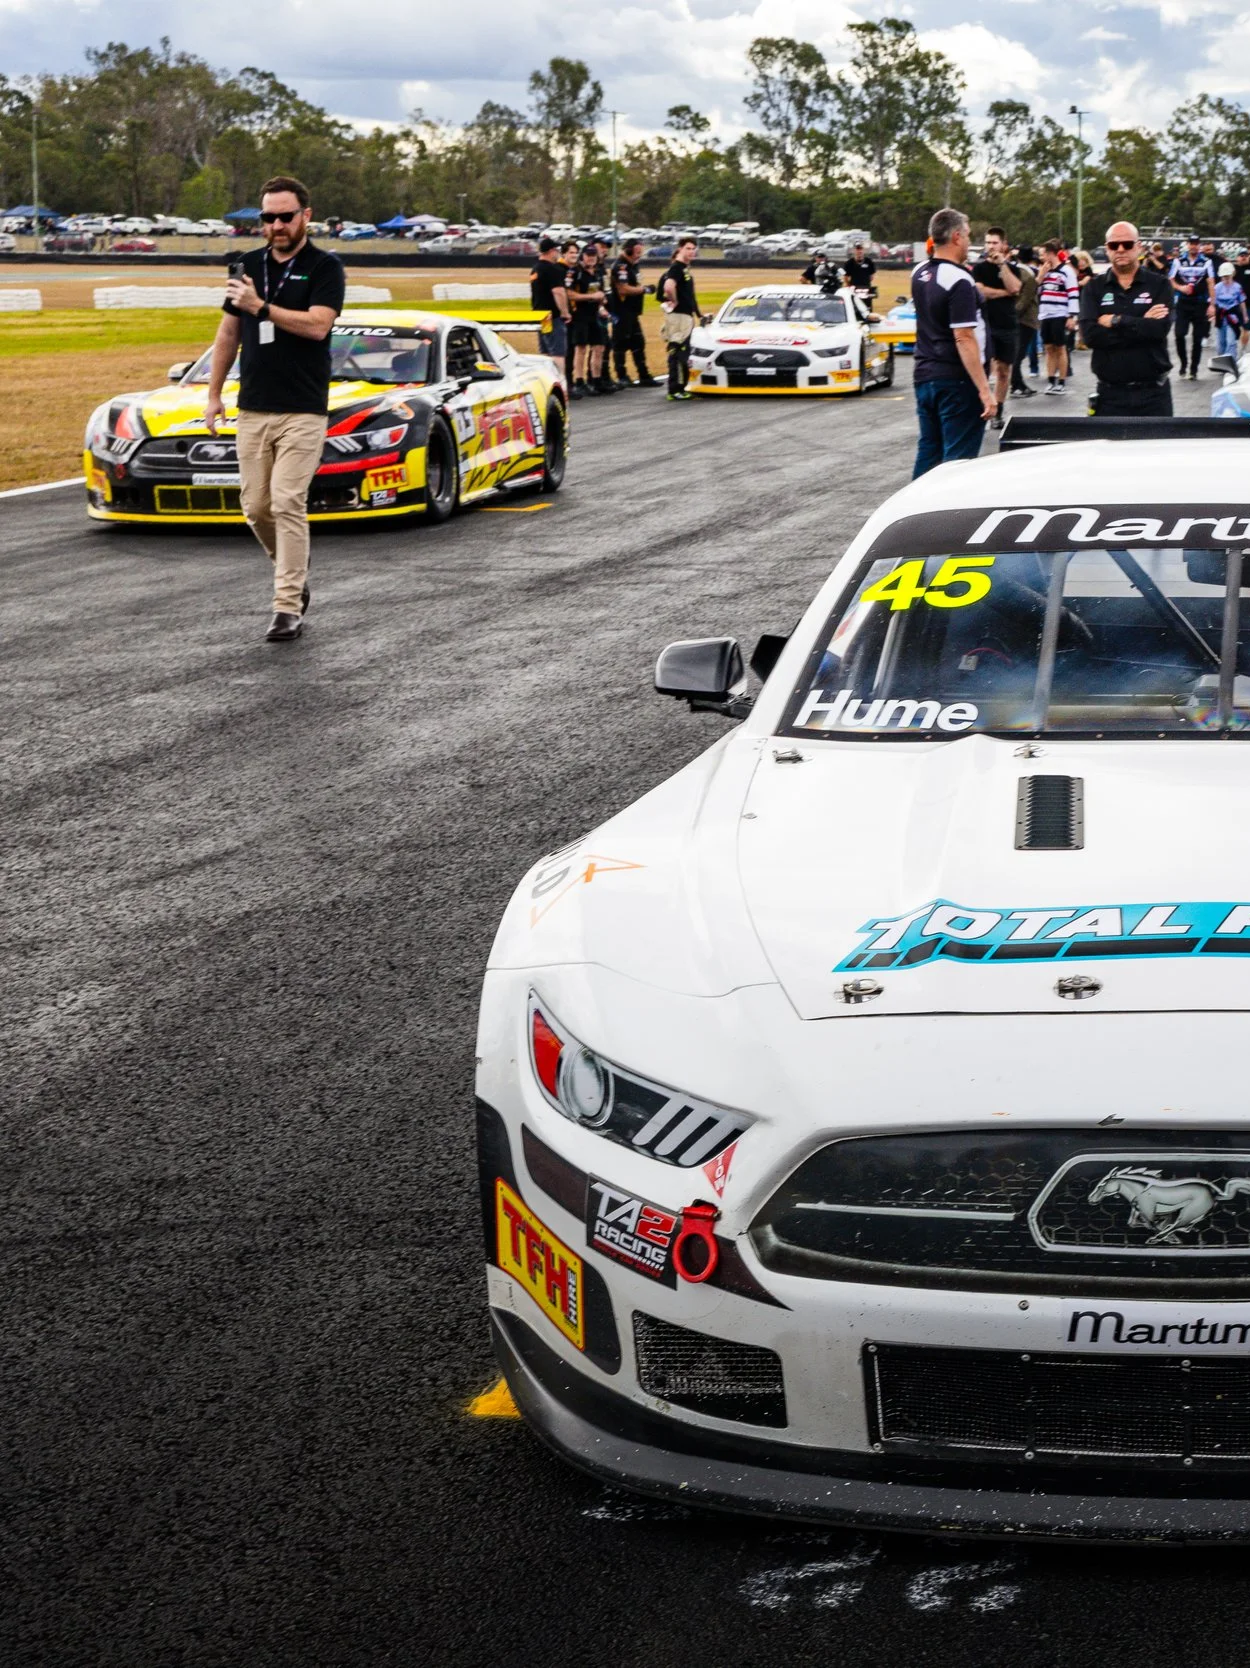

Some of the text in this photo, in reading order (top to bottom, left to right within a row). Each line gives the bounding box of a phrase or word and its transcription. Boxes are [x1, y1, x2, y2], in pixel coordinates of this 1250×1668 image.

[371, 467, 403, 487] TFH
[859, 556, 996, 611] 45
[793, 689, 979, 732] Hume
[865, 901, 1192, 950] TOTAL
[714, 1152, 725, 1191] TOW
[590, 1182, 678, 1248] TA2
[502, 1196, 569, 1318] TFH
[594, 1219, 668, 1264] RACING
